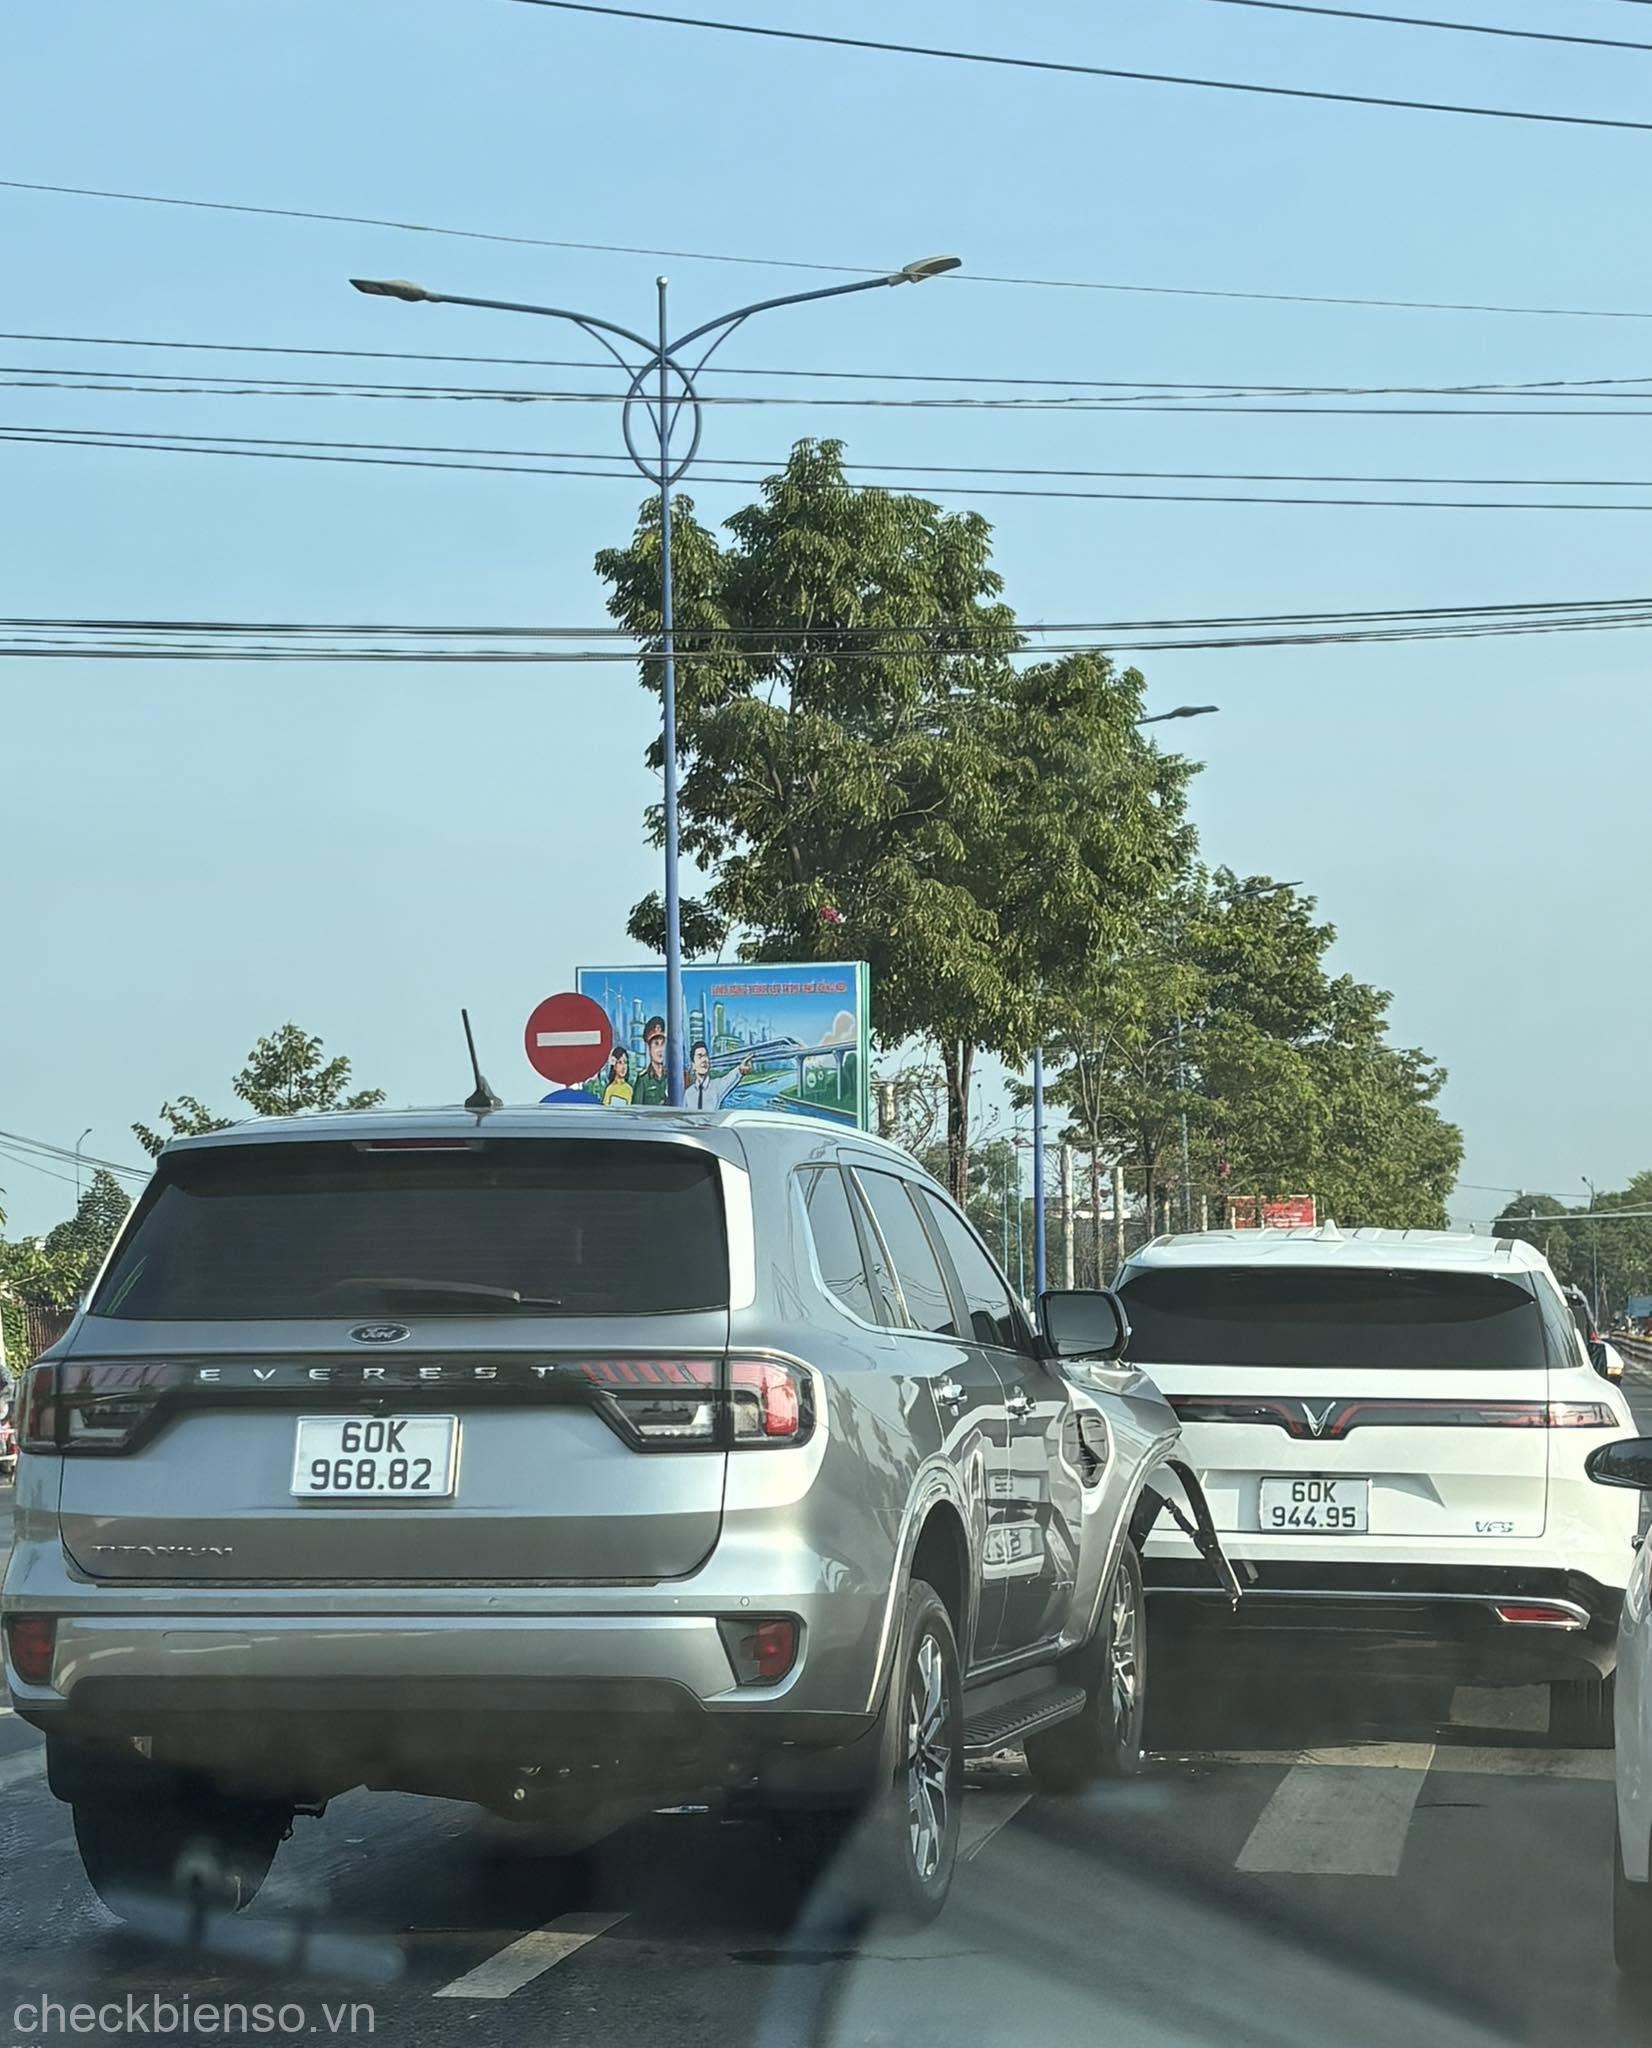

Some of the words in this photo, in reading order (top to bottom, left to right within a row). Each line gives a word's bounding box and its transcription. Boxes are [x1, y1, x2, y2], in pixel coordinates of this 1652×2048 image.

[199, 1365, 555, 1381] EVEREST
[341, 1420, 408, 1453] 60K
[310, 1458, 432, 1490] 968.82
[1292, 1481, 1337, 1503] 60K
[1272, 1506, 1356, 1528] 944.95
